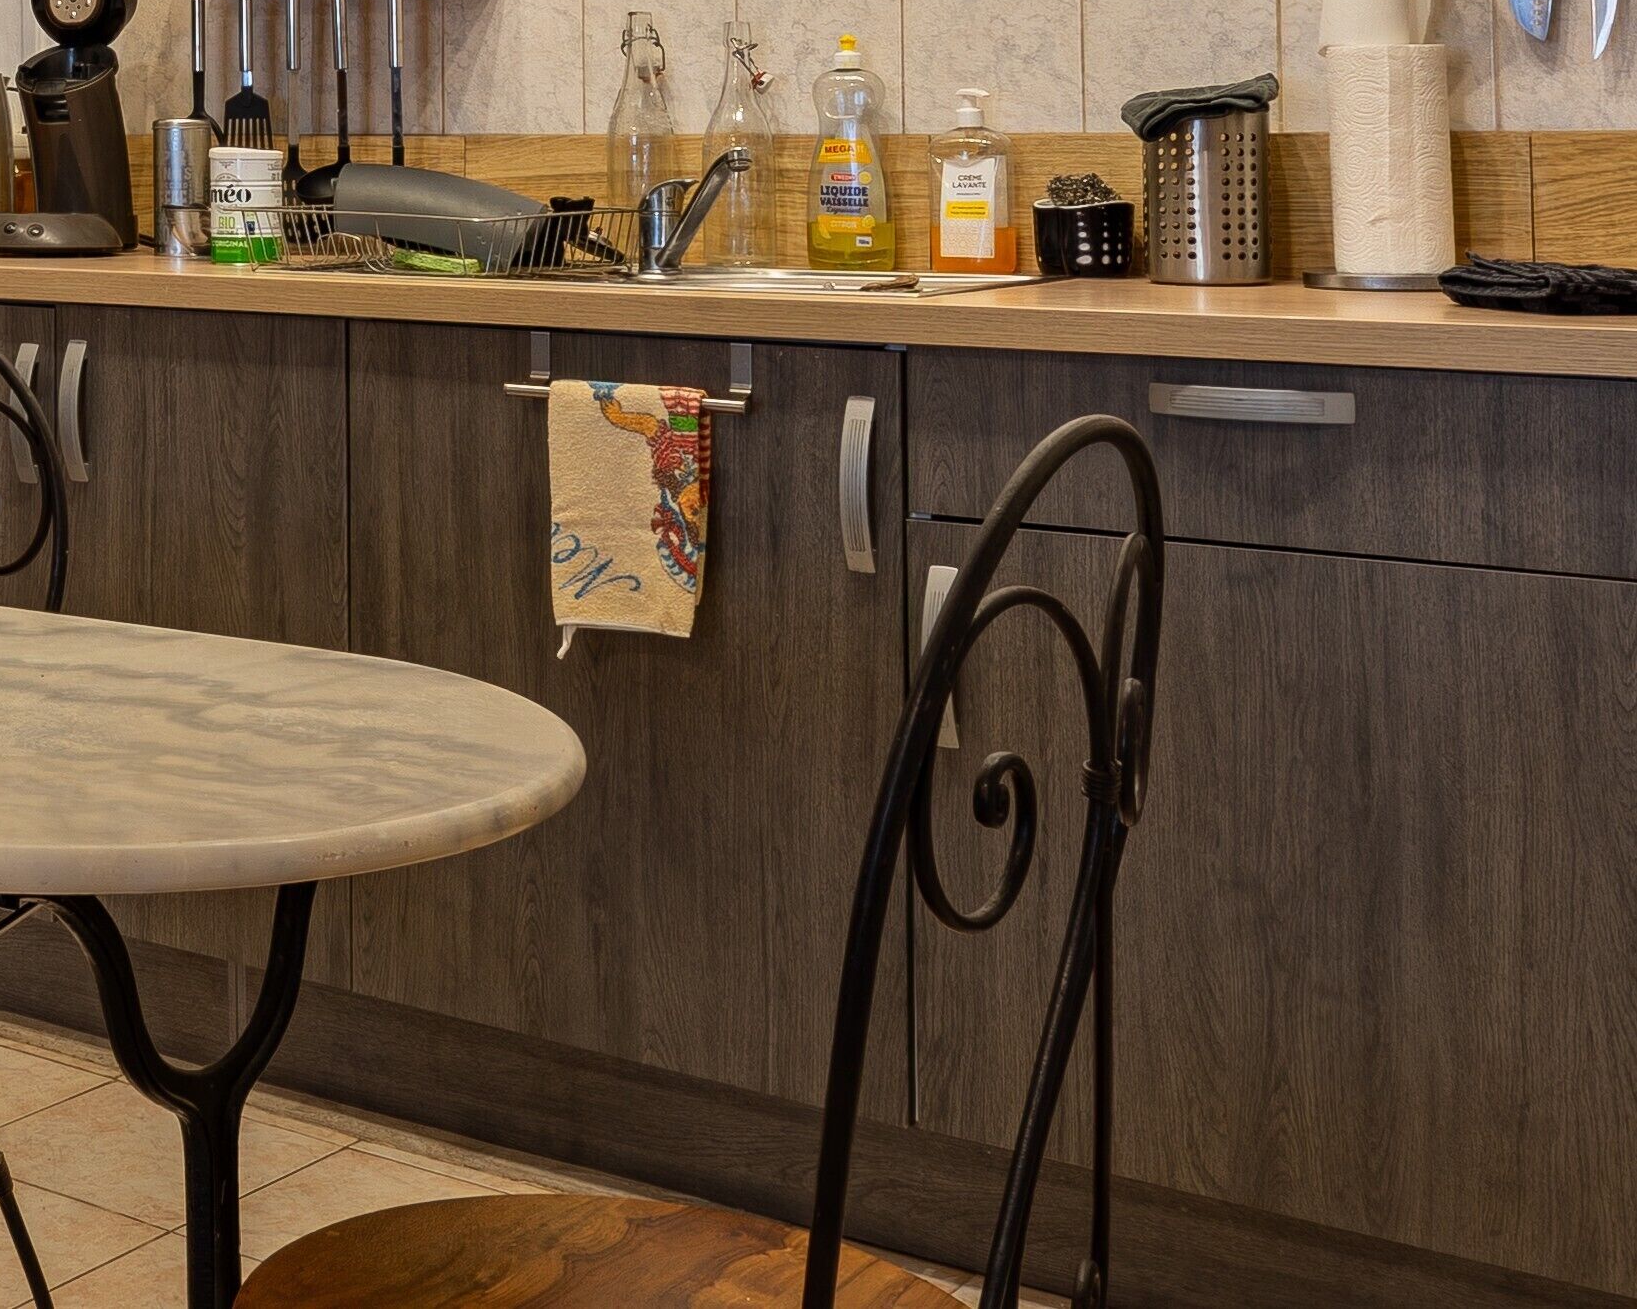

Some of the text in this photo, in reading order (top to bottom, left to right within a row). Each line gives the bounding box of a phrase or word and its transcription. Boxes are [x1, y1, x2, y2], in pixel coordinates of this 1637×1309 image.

[952, 181, 987, 189] LAVANTE
[820, 185, 869, 197] LIQUIDE
[819, 197, 869, 207] VAISSELLE
